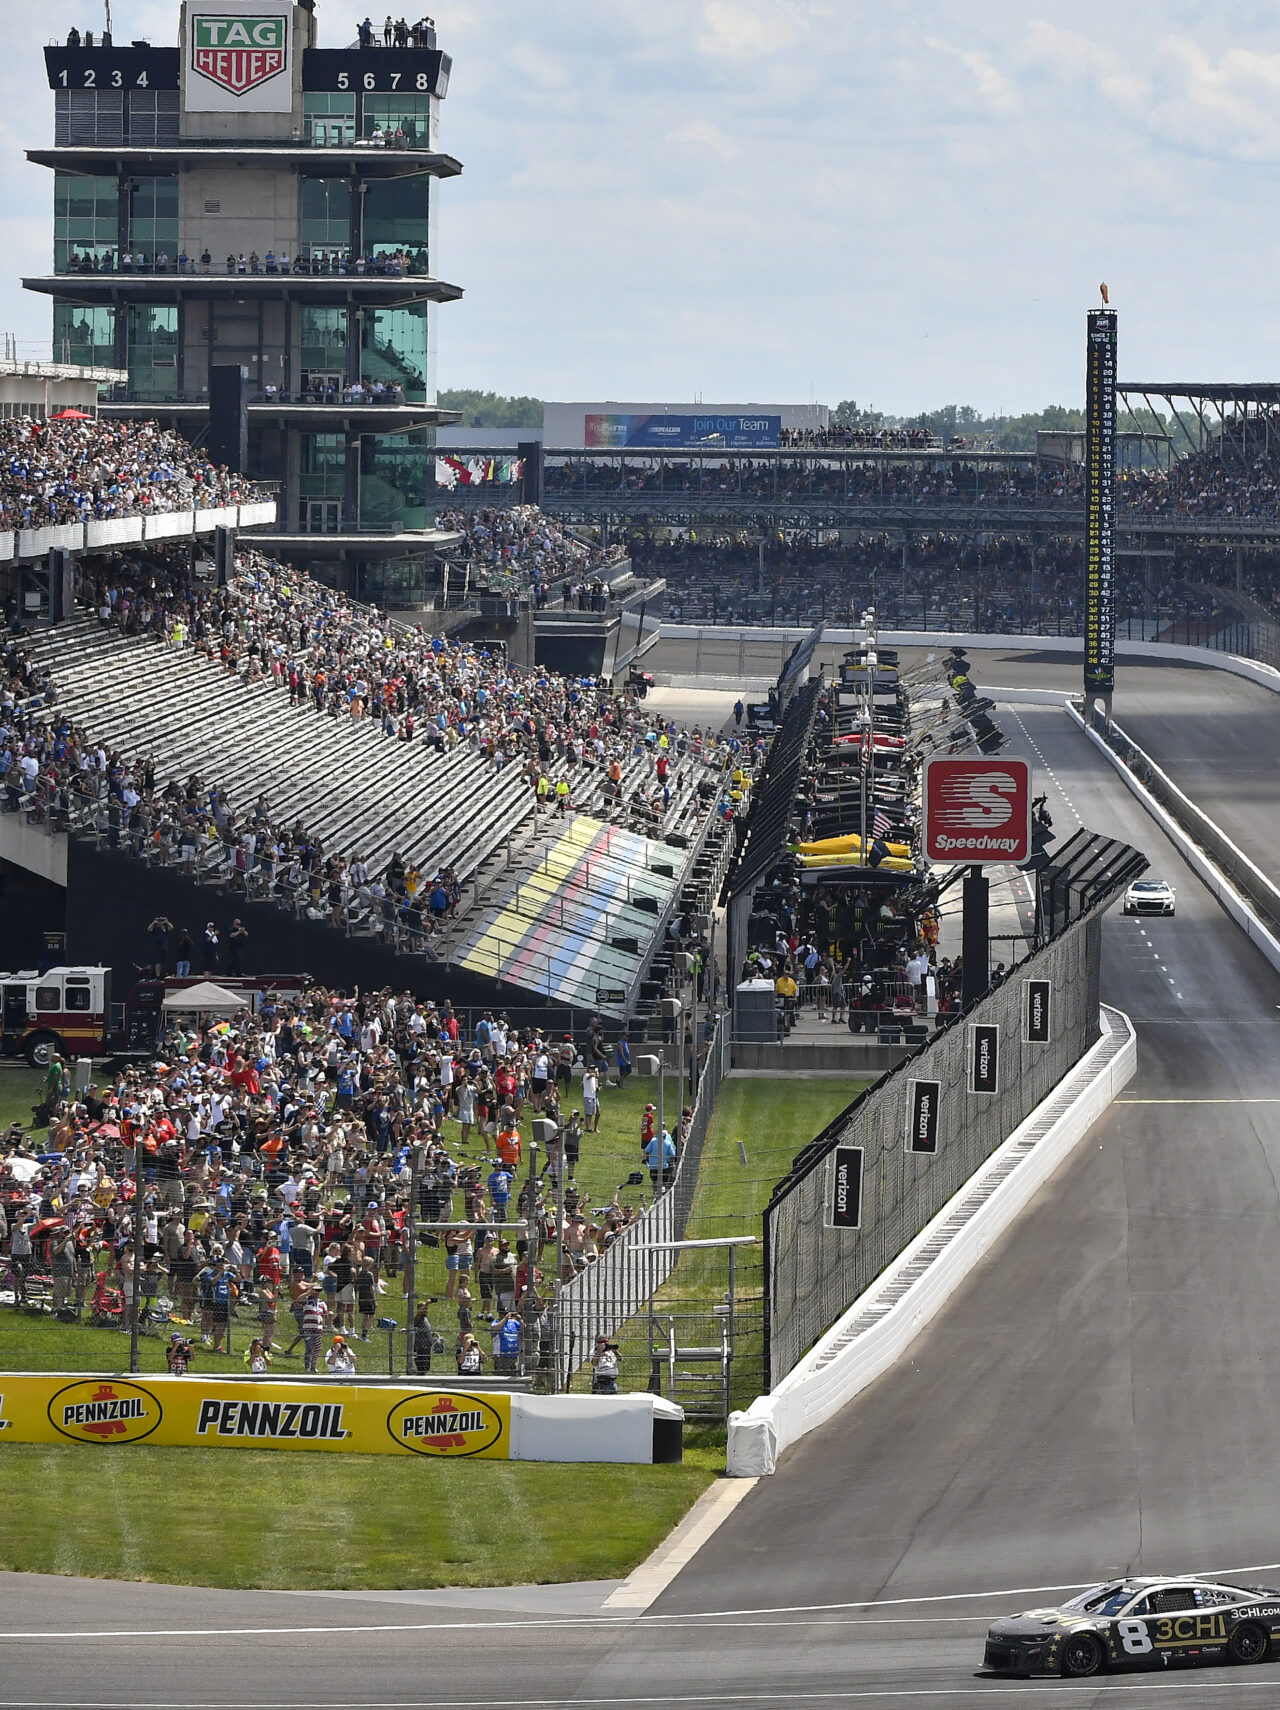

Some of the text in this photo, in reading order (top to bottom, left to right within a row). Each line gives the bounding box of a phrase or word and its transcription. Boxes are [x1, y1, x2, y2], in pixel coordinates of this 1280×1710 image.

[202, 22, 276, 45] TAG
[58, 70, 149, 87] 1 2 3 4
[200, 52, 279, 88] HEUER
[337, 72, 428, 90] 5 6 7 8
[693, 418, 714, 432] Join
[717, 418, 736, 431] Our
[738, 418, 768, 431] Team
[935, 834, 1019, 853] Speedway
[1033, 992, 1041, 1030] verizon
[980, 1038, 989, 1079] verizon
[919, 1094, 931, 1139] verizon
[837, 1163, 850, 1213] verizon
[63, 1398, 146, 1427] PENNZOIL
[196, 1399, 348, 1440] PENNZOIL
[402, 1411, 486, 1438] PENNZOIL
[1231, 1607, 1280, 1618] 3CHI.COM
[1117, 1620, 1153, 1654] 8
[1156, 1615, 1226, 1640] 3CHI
